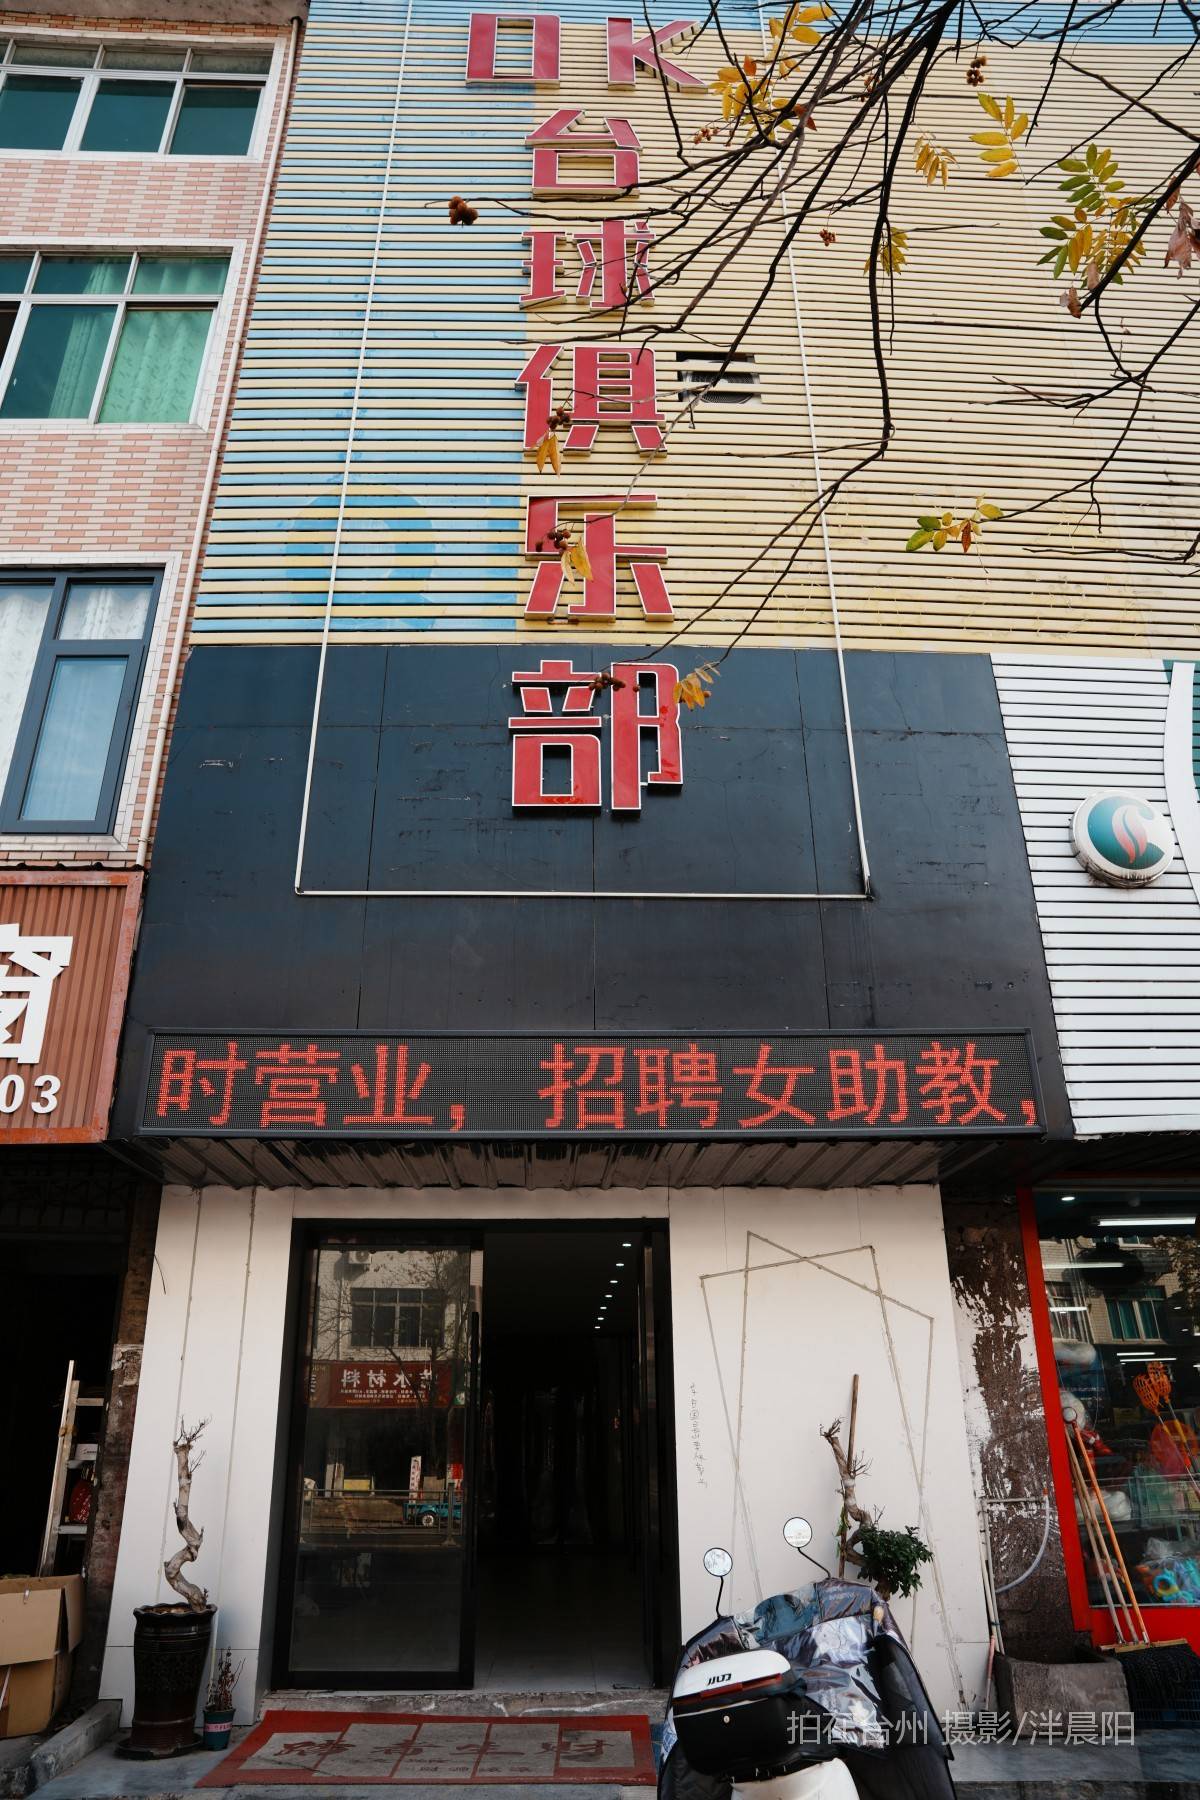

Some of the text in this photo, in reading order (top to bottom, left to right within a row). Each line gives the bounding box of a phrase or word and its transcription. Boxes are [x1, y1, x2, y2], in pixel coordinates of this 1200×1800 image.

[508, 108, 685, 812] 台球俱乐部
